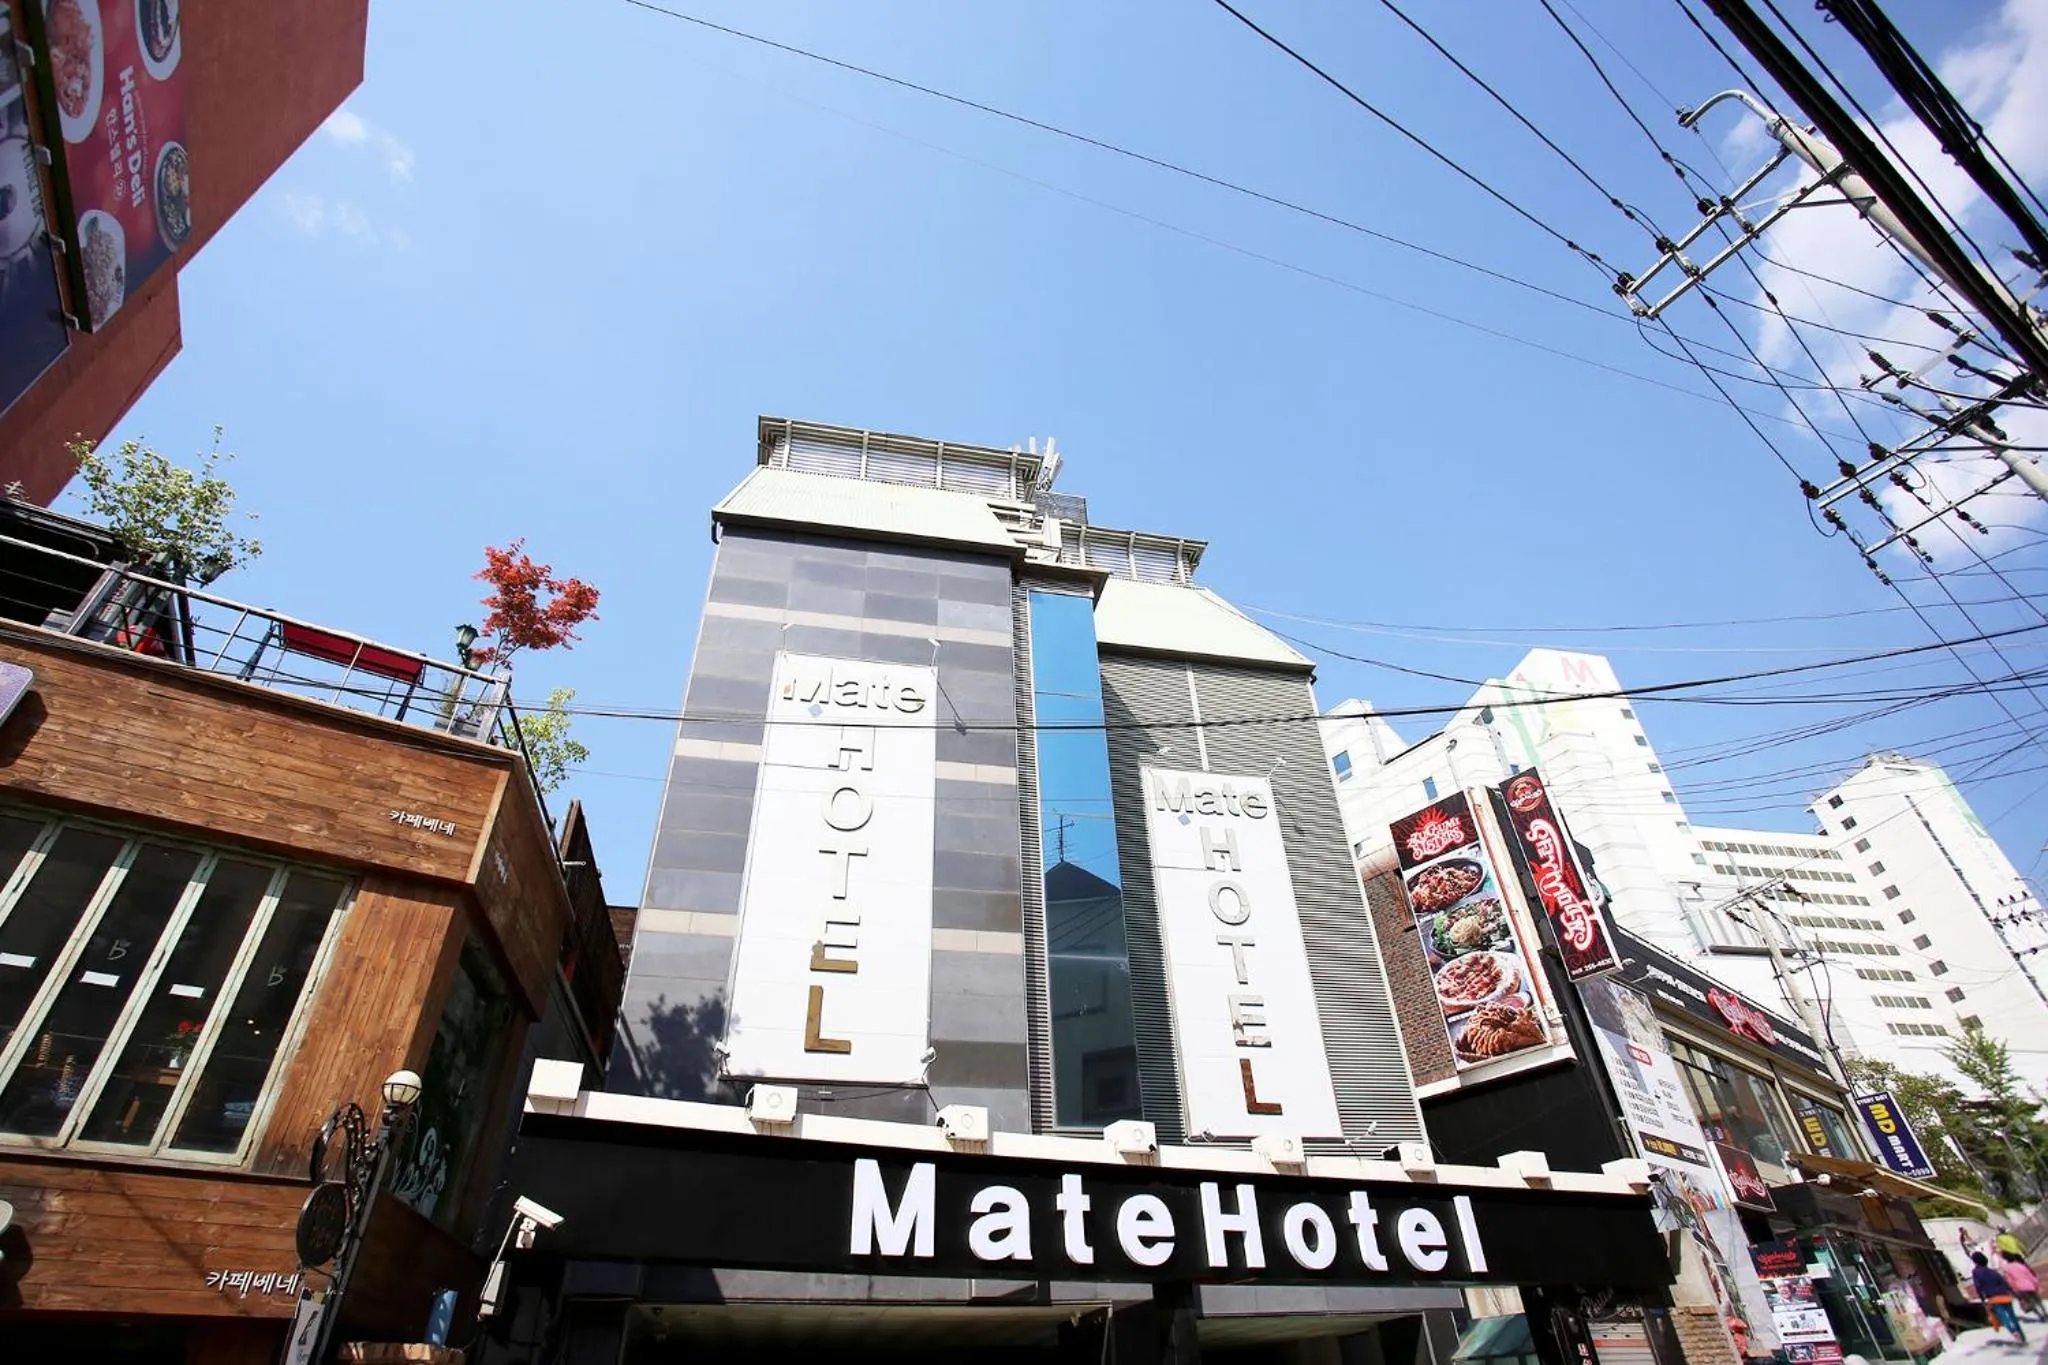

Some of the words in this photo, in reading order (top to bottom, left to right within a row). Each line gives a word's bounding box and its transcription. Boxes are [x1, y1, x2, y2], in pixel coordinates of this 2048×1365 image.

[119, 65, 137, 150] Han's
[127, 150, 145, 208] Deli
[782, 668, 927, 715] Mate
[1153, 775, 1269, 819] Mate
[388, 810, 457, 836] 카페베네
[1412, 827, 1465, 860] SISTERS
[804, 725, 876, 1055] HOTEL
[1200, 826, 1283, 1116] HOTEL
[1868, 1103, 1897, 1135] MD
[1886, 1135, 1915, 1169] MART
[205, 1269, 299, 1295] 카페베네
